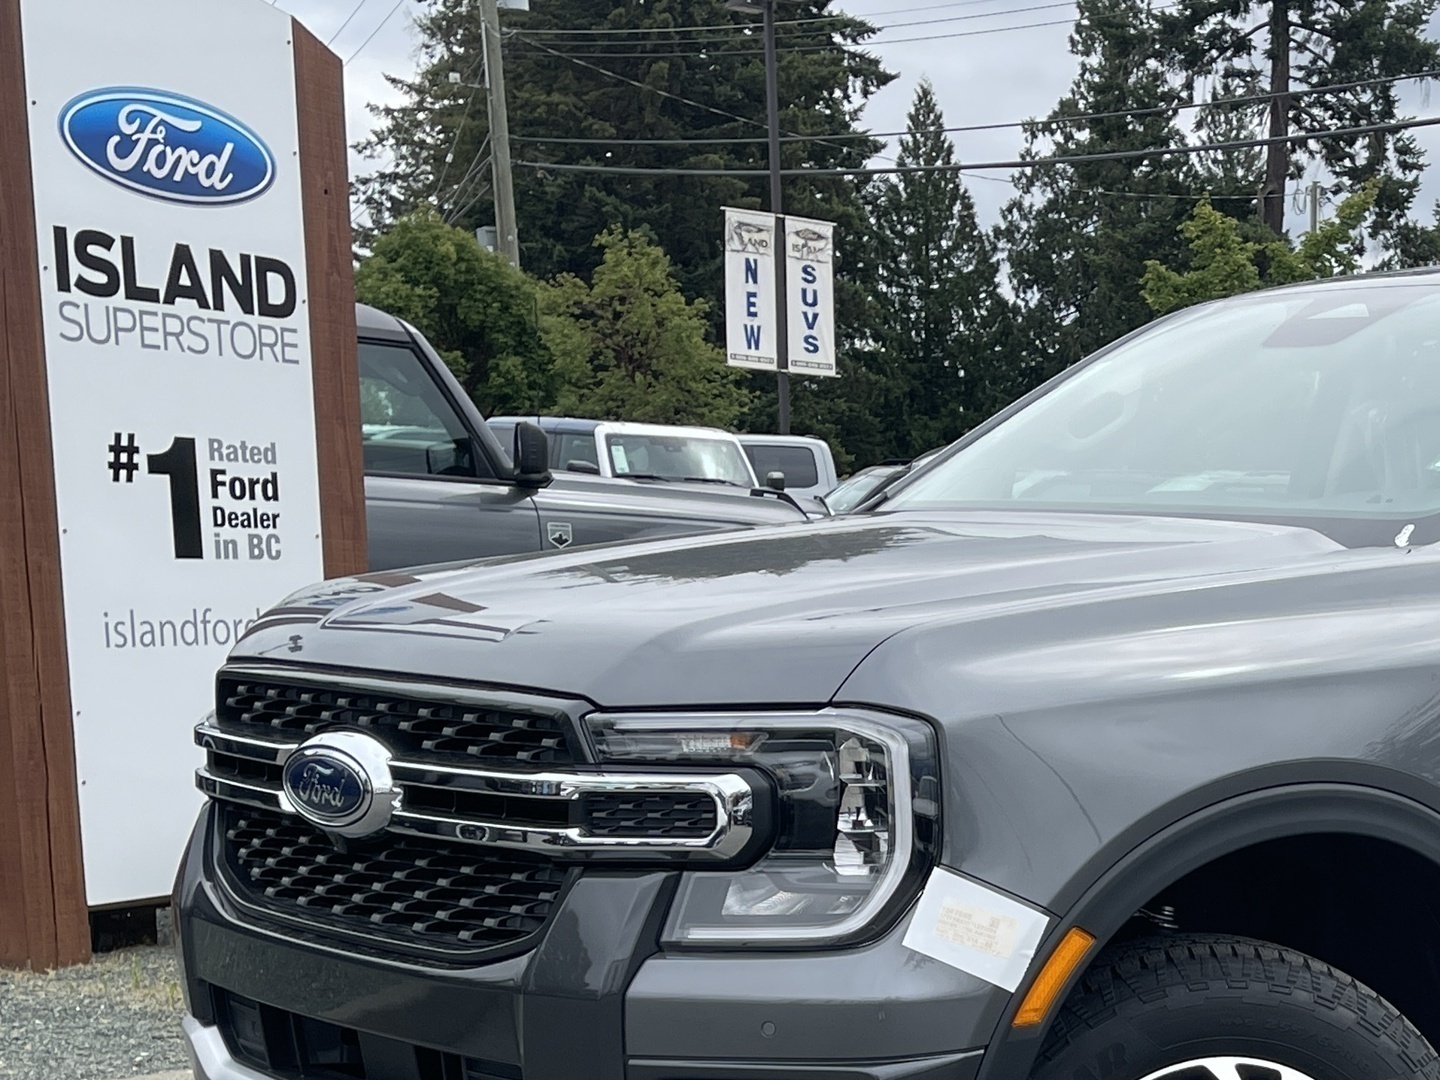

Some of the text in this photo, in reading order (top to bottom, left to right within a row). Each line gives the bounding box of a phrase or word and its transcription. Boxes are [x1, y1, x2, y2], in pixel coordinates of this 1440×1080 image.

[106, 103, 235, 190] Ford
[53, 225, 297, 319] ISLAND
[743, 257, 761, 351] NEW
[58, 300, 300, 365] SUPERSTORE
[801, 264, 820, 354] SUVS
[208, 438, 277, 465] Rated
[108, 432, 204, 560] #1
[209, 468, 280, 502] Ford
[212, 506, 281, 529] Dealer
[214, 532, 282, 560] in BC
[299, 763, 345, 808] Ford
